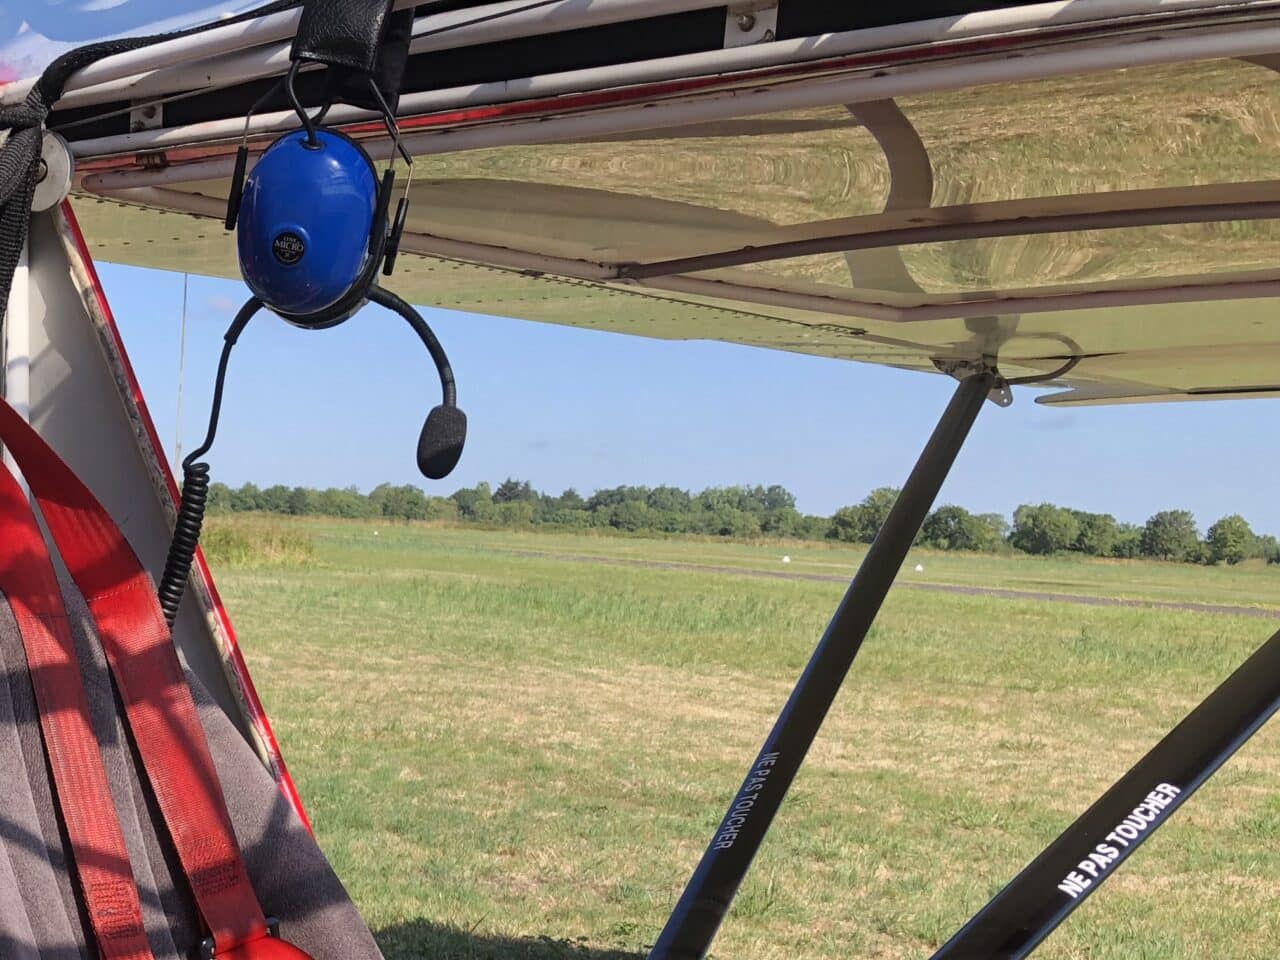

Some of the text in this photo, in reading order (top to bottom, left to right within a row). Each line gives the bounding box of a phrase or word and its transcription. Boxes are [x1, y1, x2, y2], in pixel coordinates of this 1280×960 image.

[713, 752, 780, 850] NE PAS TOUCHER
[1058, 783, 1181, 898] NE PAS TOUCHER
